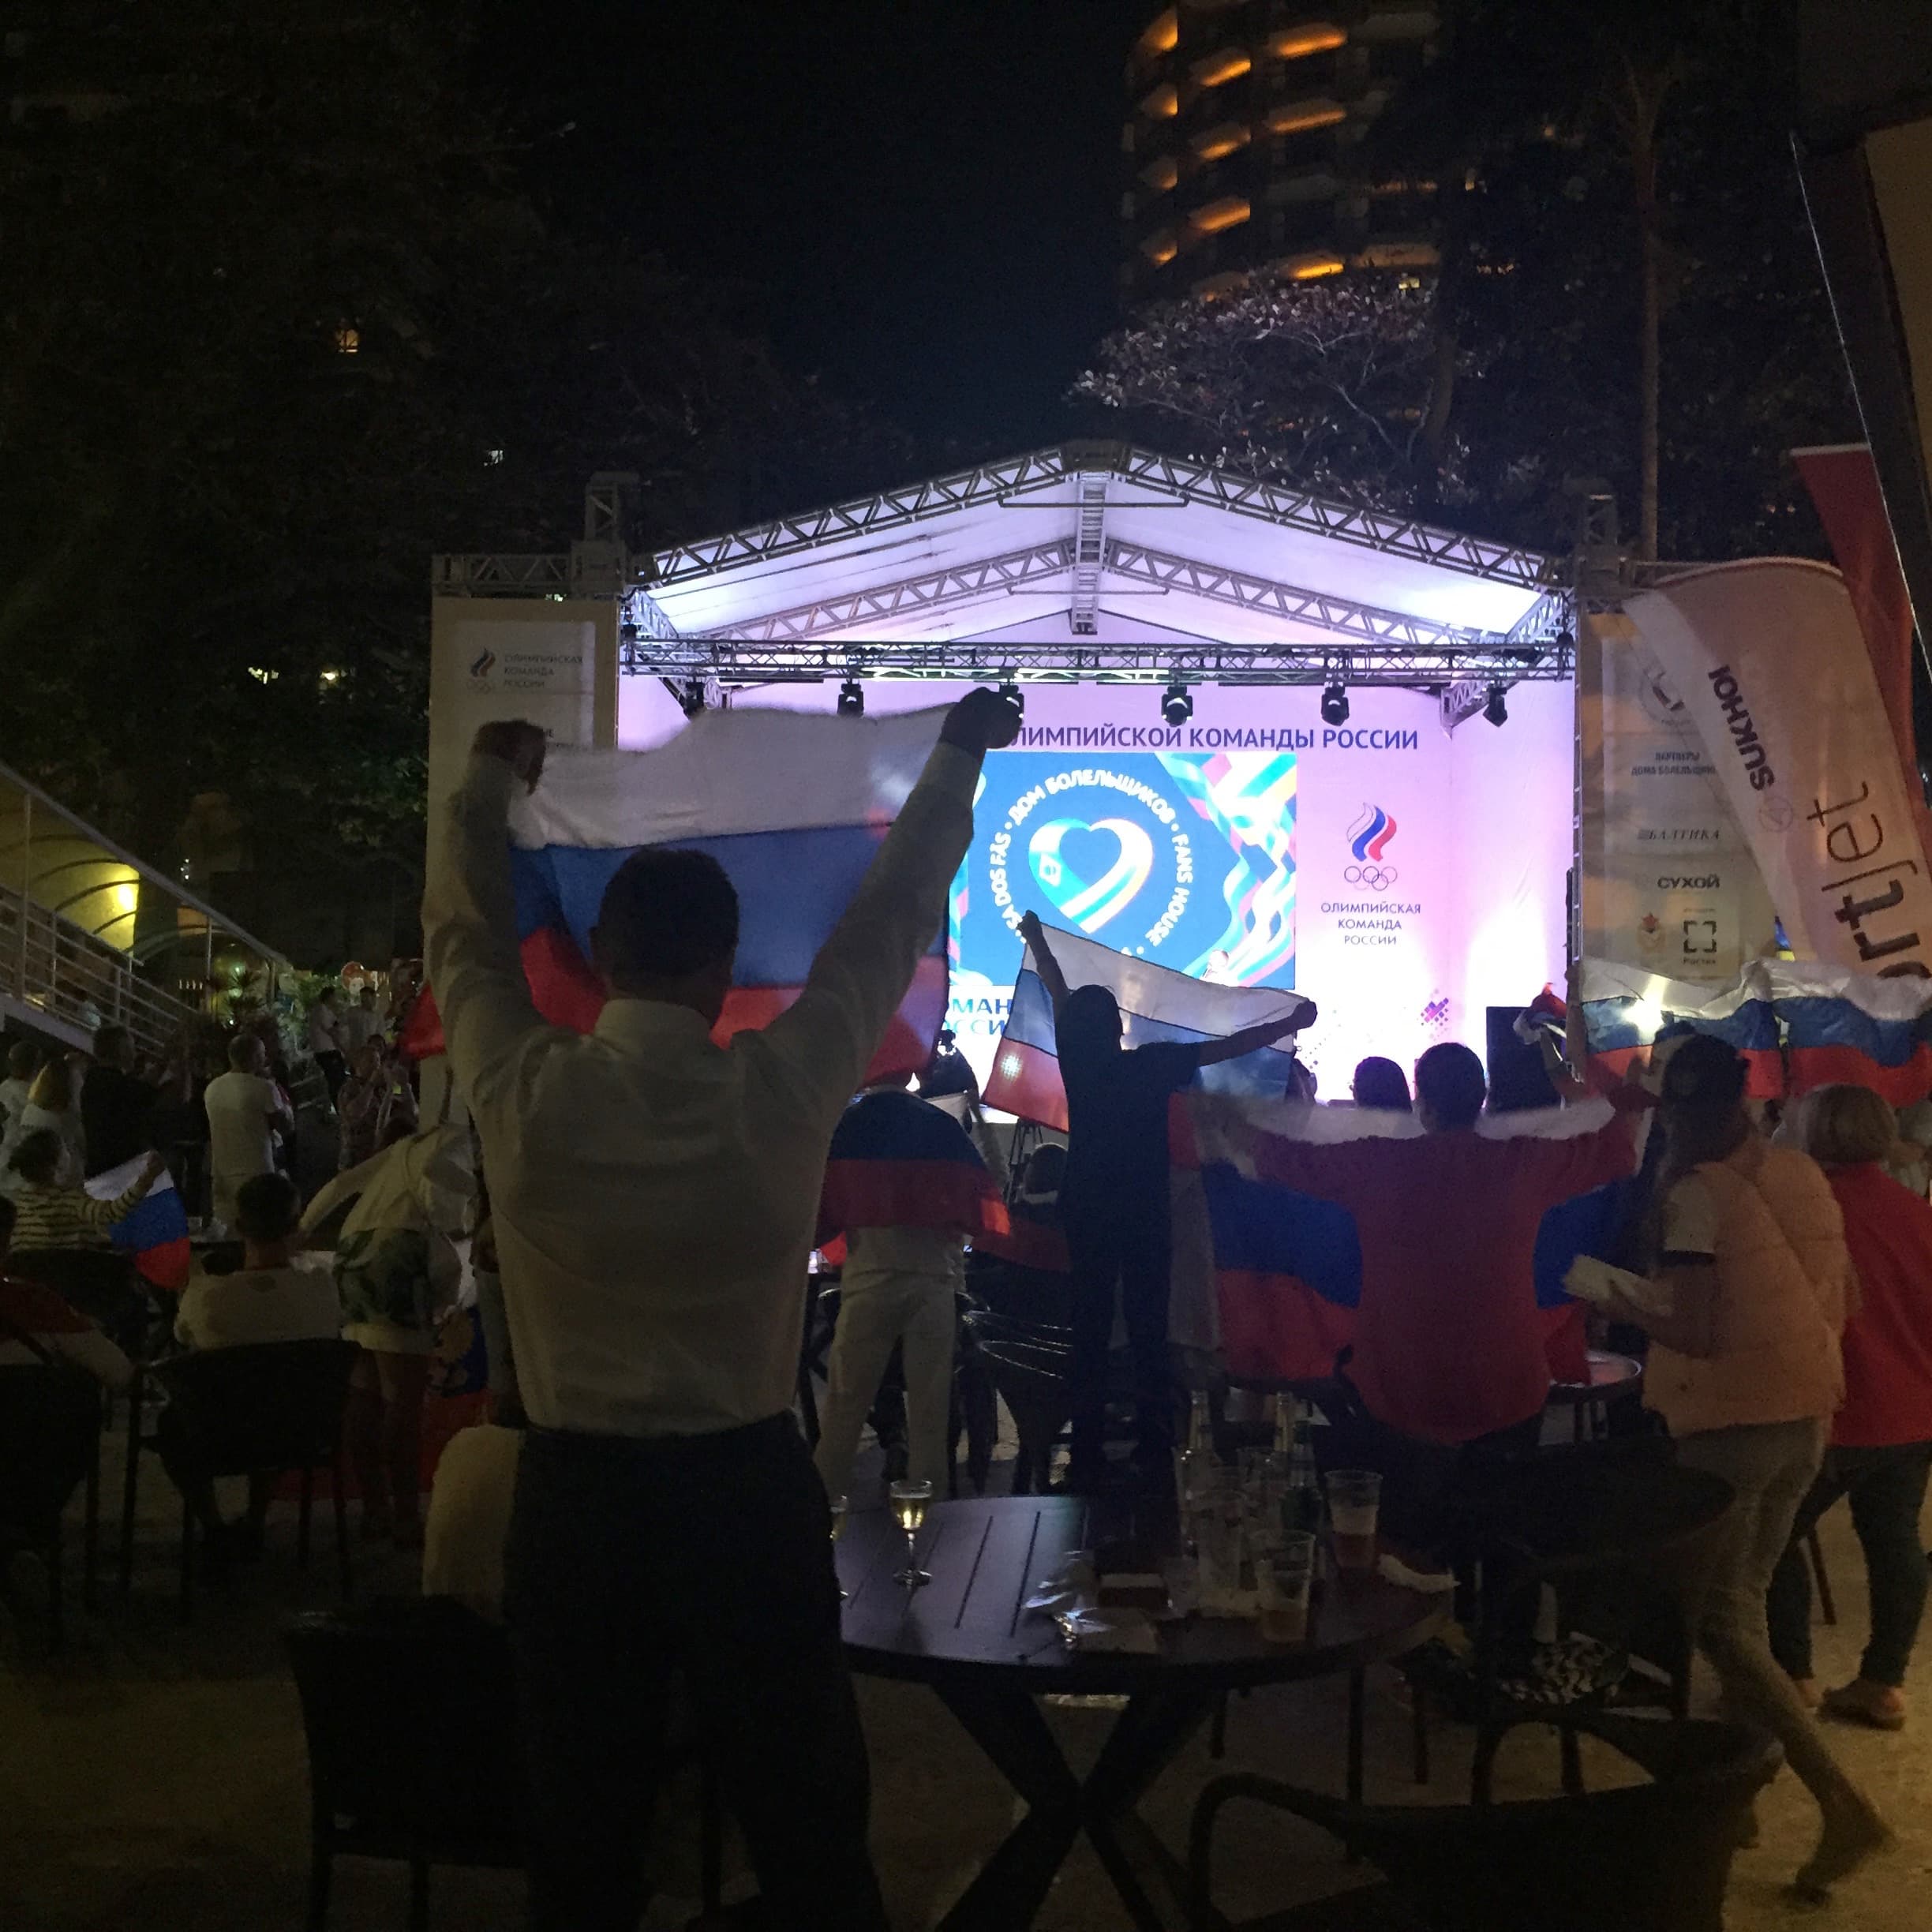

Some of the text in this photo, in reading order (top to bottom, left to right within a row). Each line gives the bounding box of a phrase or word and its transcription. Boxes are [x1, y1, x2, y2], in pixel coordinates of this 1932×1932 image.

[1011, 723, 1418, 751] ЛИМПИЙСКОЙ КОМАНДЫ РОССИИ
[1708, 665, 1775, 791] SUKHOI
[1008, 769, 1176, 826] ДОМ БОЛЕЛЬЩИКОВ
[989, 867, 1012, 907] DOS
[1144, 833, 1194, 947] FANS HOUSE
[1657, 874, 1720, 889] СУХОЙ
[1320, 900, 1421, 914] ОЛИМПИЙСКАЯ
[1338, 919, 1402, 930] КОМАНДА
[1344, 934, 1397, 945] РОССИИ
